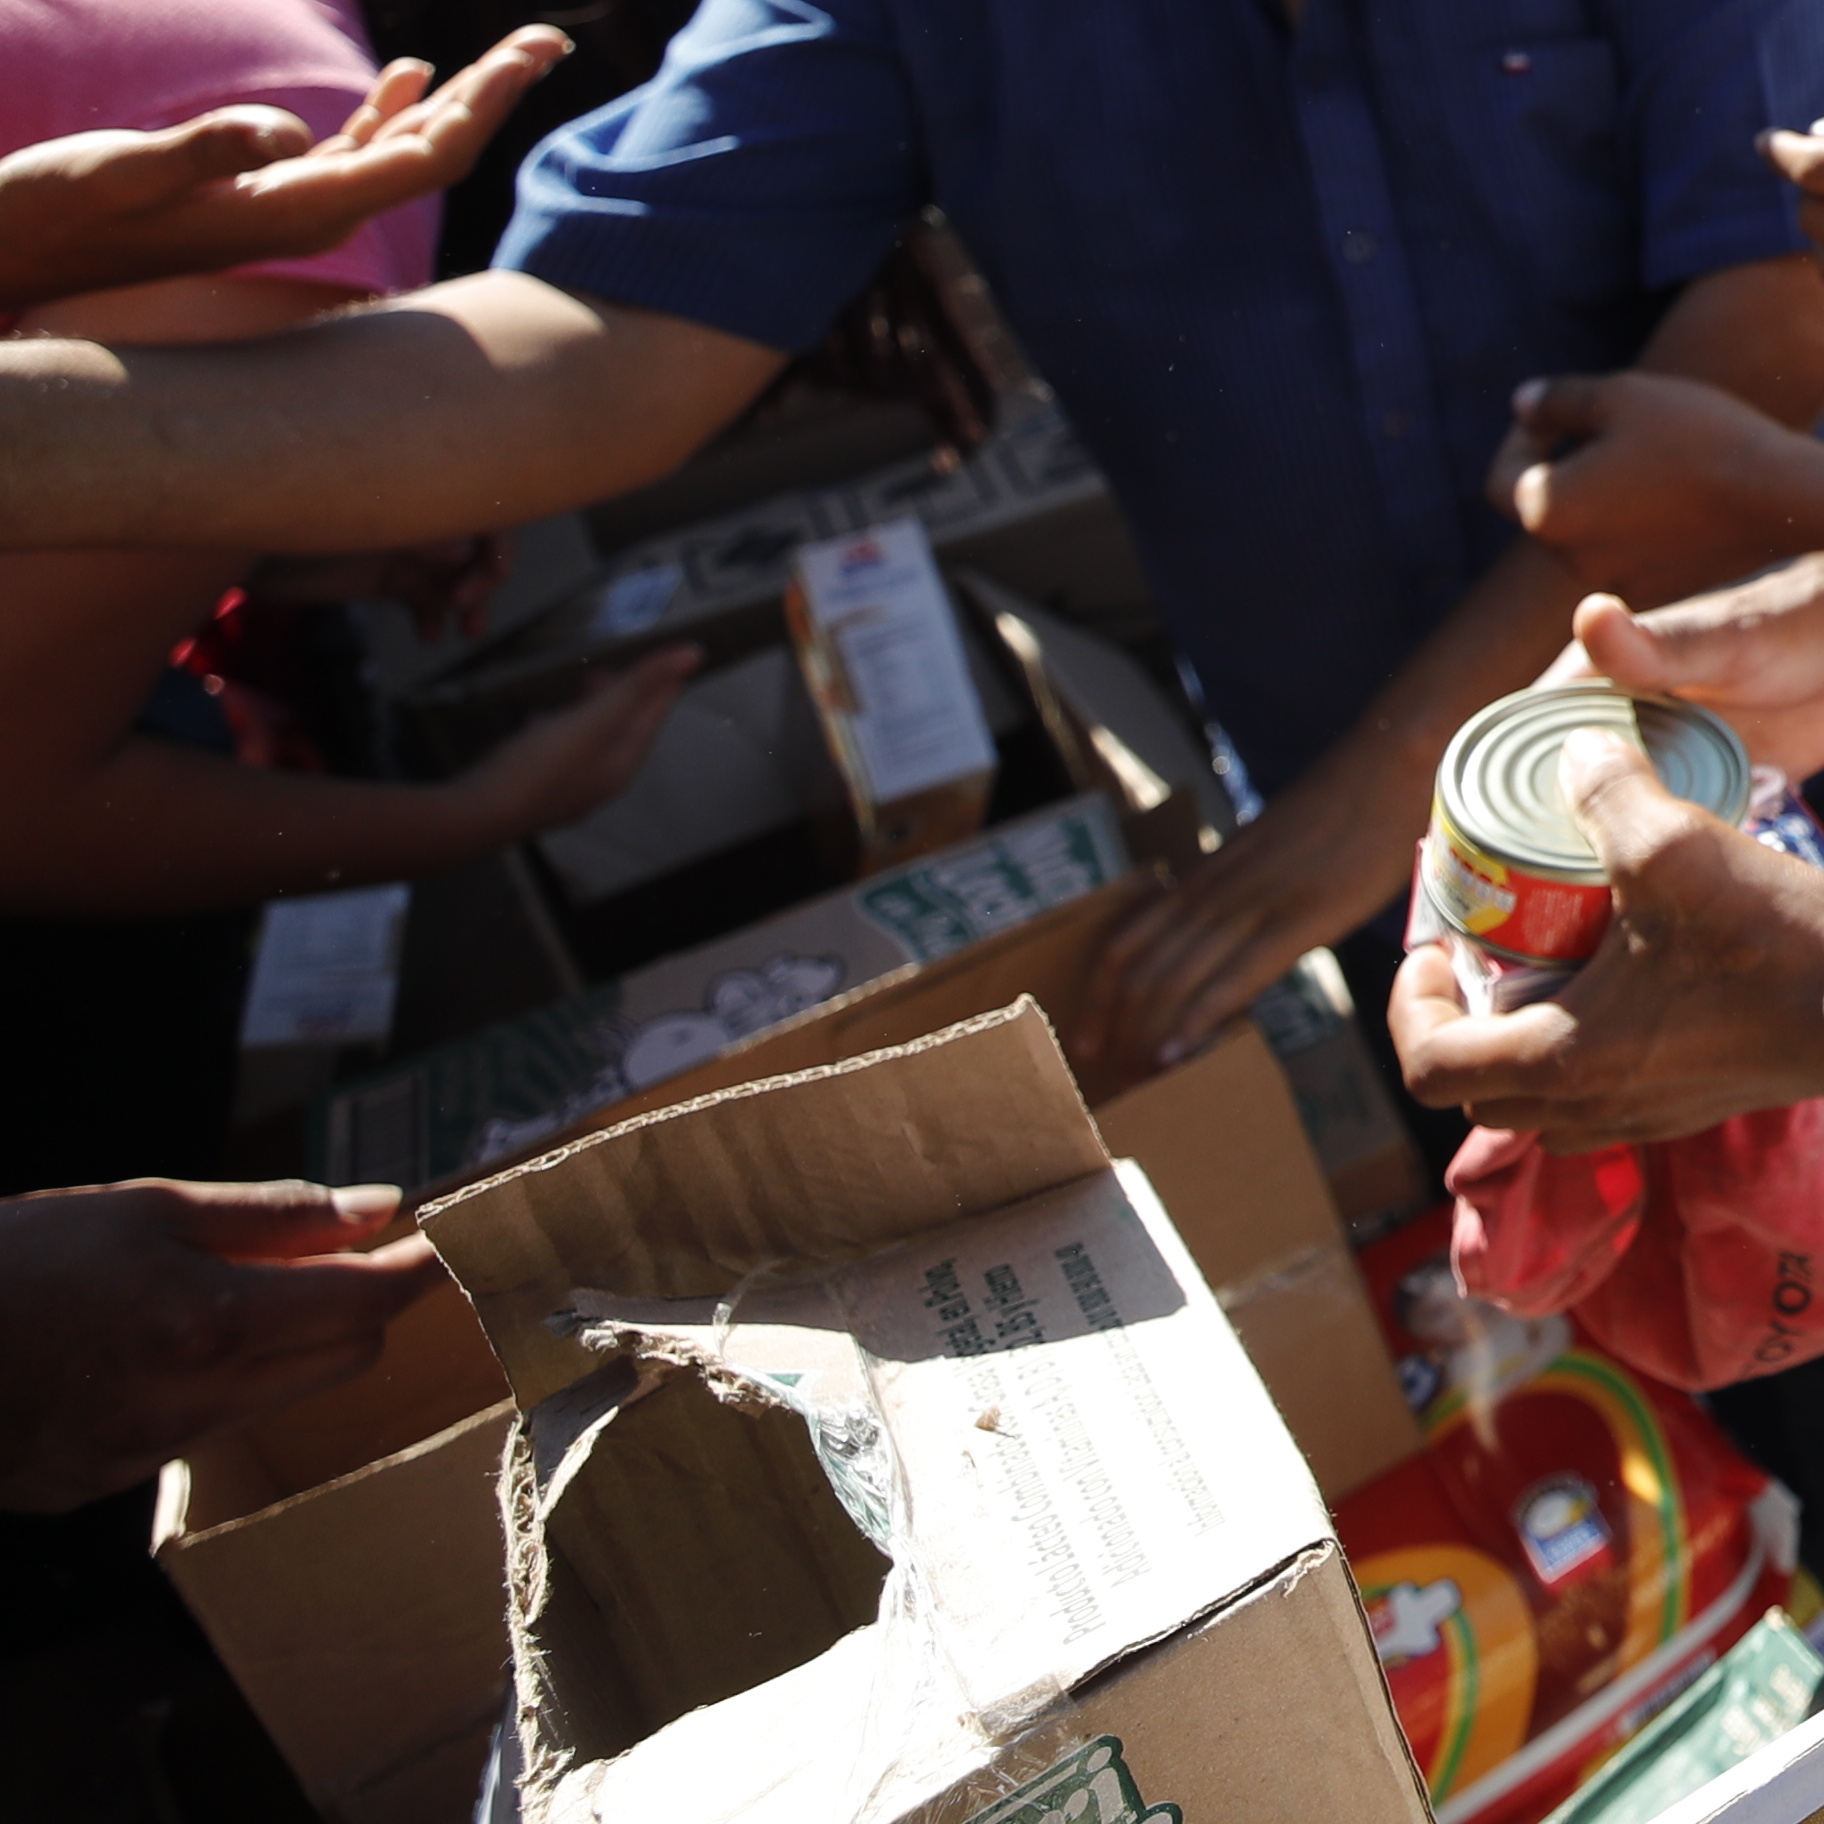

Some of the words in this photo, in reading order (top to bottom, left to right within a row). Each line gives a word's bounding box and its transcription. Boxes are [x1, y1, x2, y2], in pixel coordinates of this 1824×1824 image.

[988, 1433, 1051, 1523] Combinado
[1045, 1402, 1099, 1482] Vitaminas
[1027, 1513, 1075, 1576] Lácteo
[1082, 1496, 1149, 1587] Adicionado
[1048, 1563, 1105, 1645] Producto
